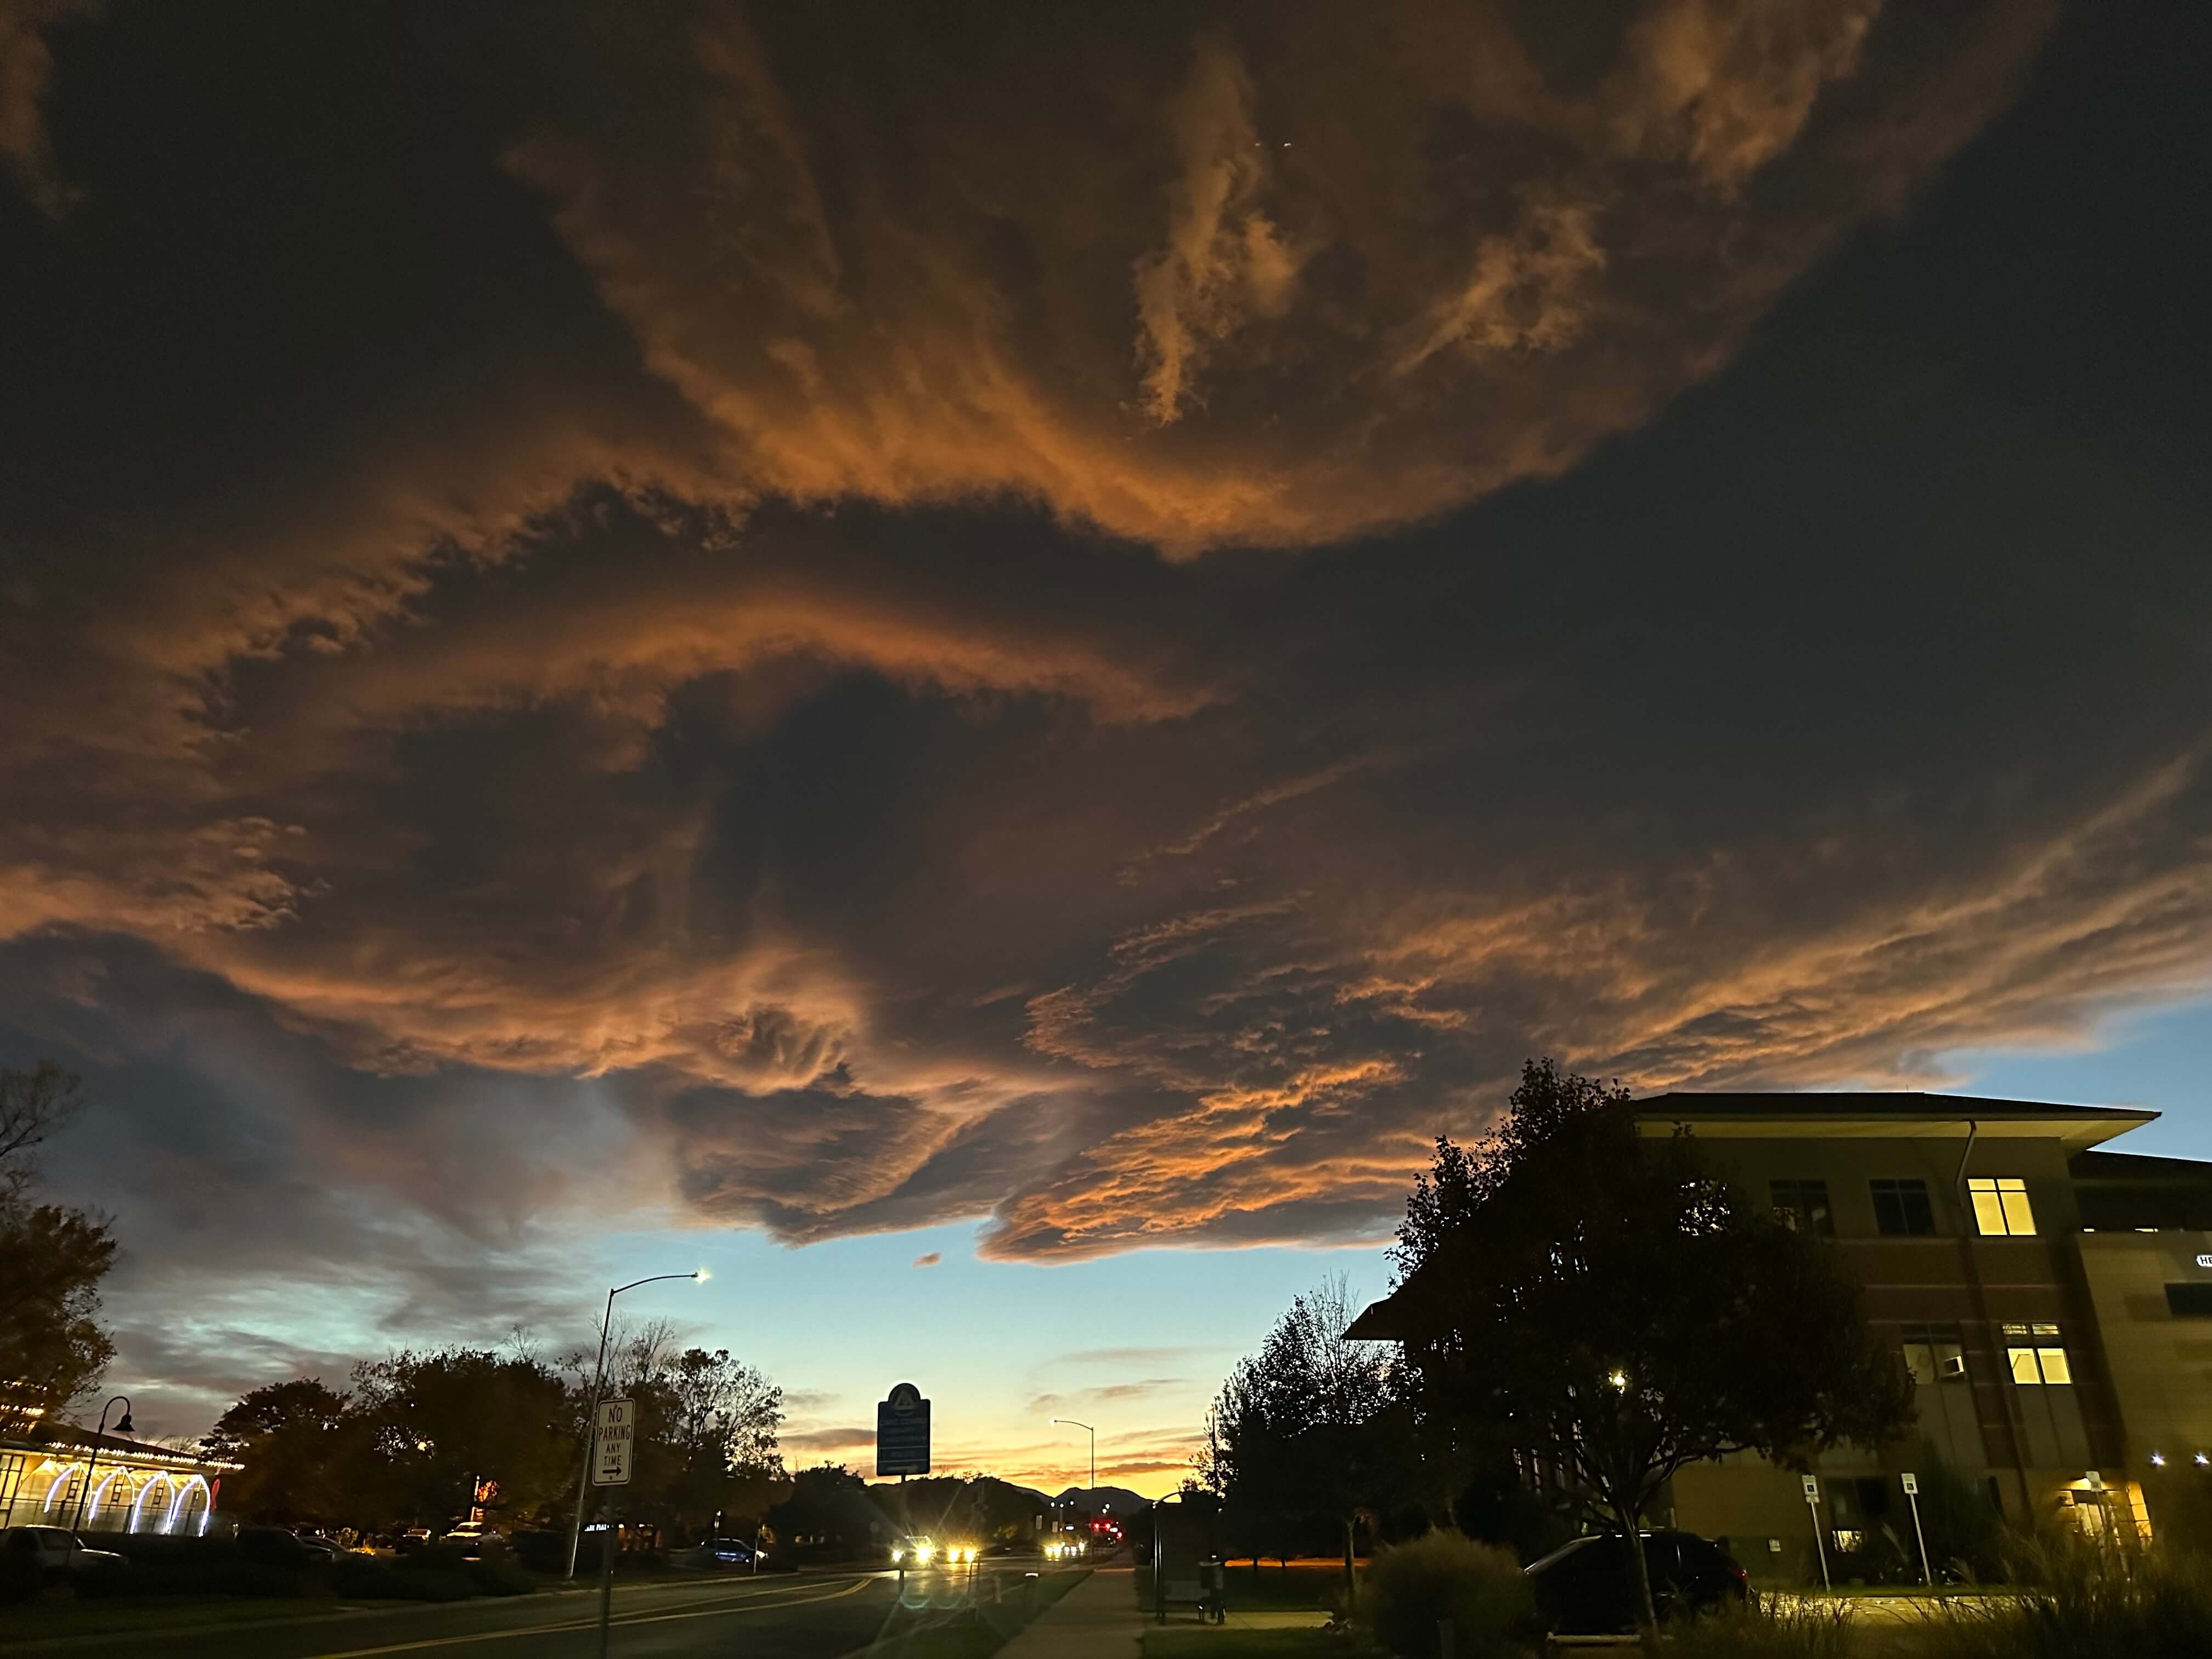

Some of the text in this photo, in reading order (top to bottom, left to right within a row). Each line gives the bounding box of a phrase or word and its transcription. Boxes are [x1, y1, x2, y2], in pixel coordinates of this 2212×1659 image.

[609, 1408, 623, 1423] NO
[599, 1425, 630, 1441] PARKING
[606, 1443, 620, 1453] ANY
[604, 1455, 621, 1466] TIME
